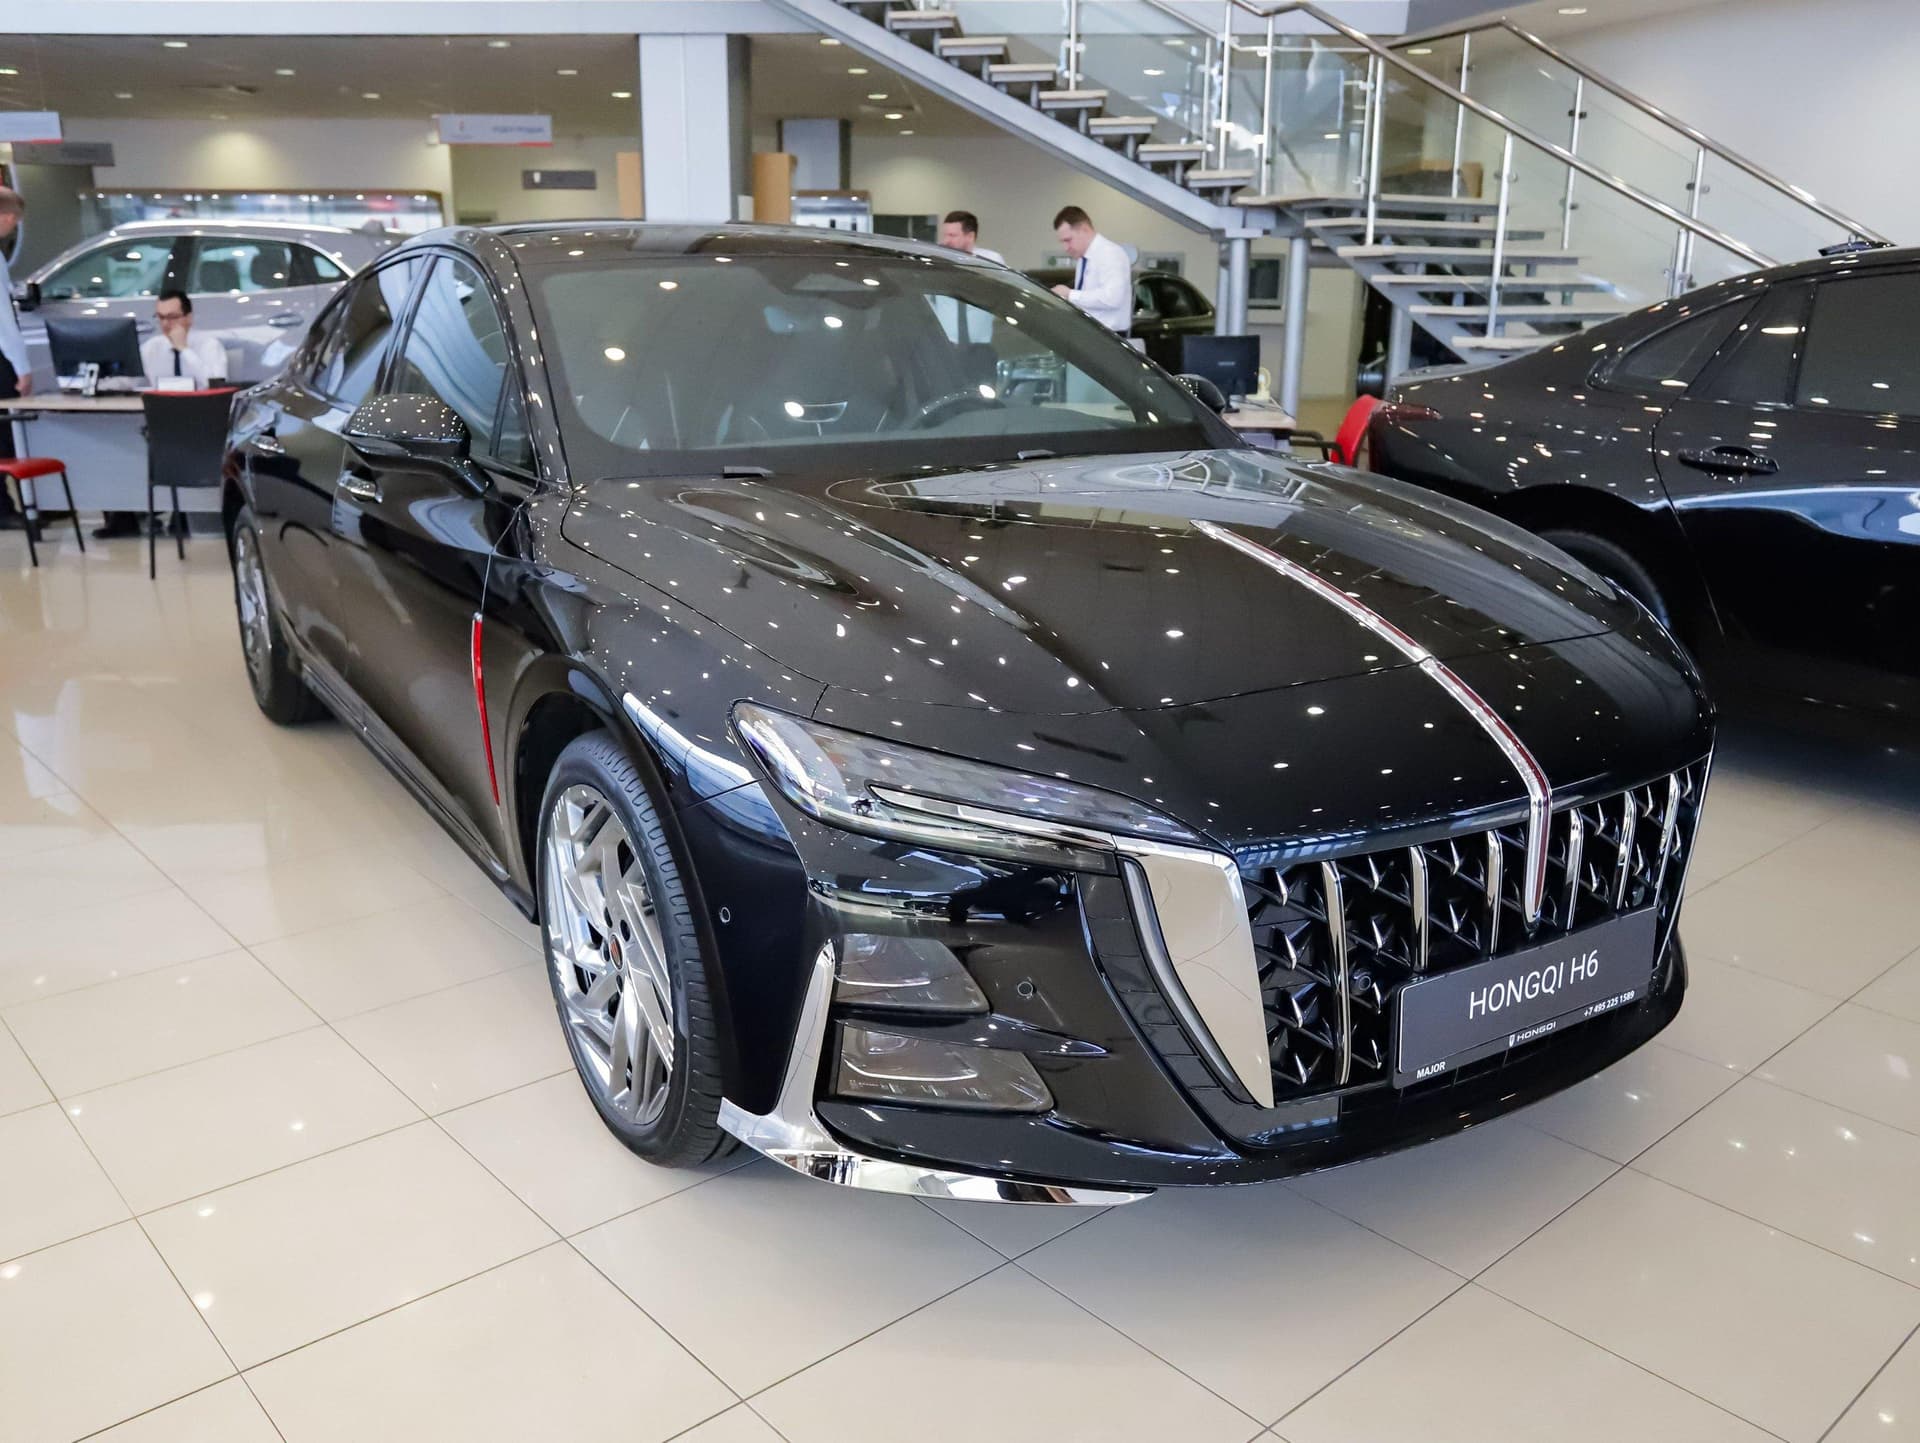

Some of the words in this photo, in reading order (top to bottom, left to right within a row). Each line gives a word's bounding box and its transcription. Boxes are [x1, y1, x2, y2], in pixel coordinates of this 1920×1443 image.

[1469, 962, 1563, 1019] HONGQI
[1570, 949, 1600, 985] H6
[1584, 1007, 1593, 1016] +7
[1594, 1002, 1606, 1012] 495
[1607, 997, 1618, 1008] 225
[1416, 1061, 1446, 1079] MAJOR
